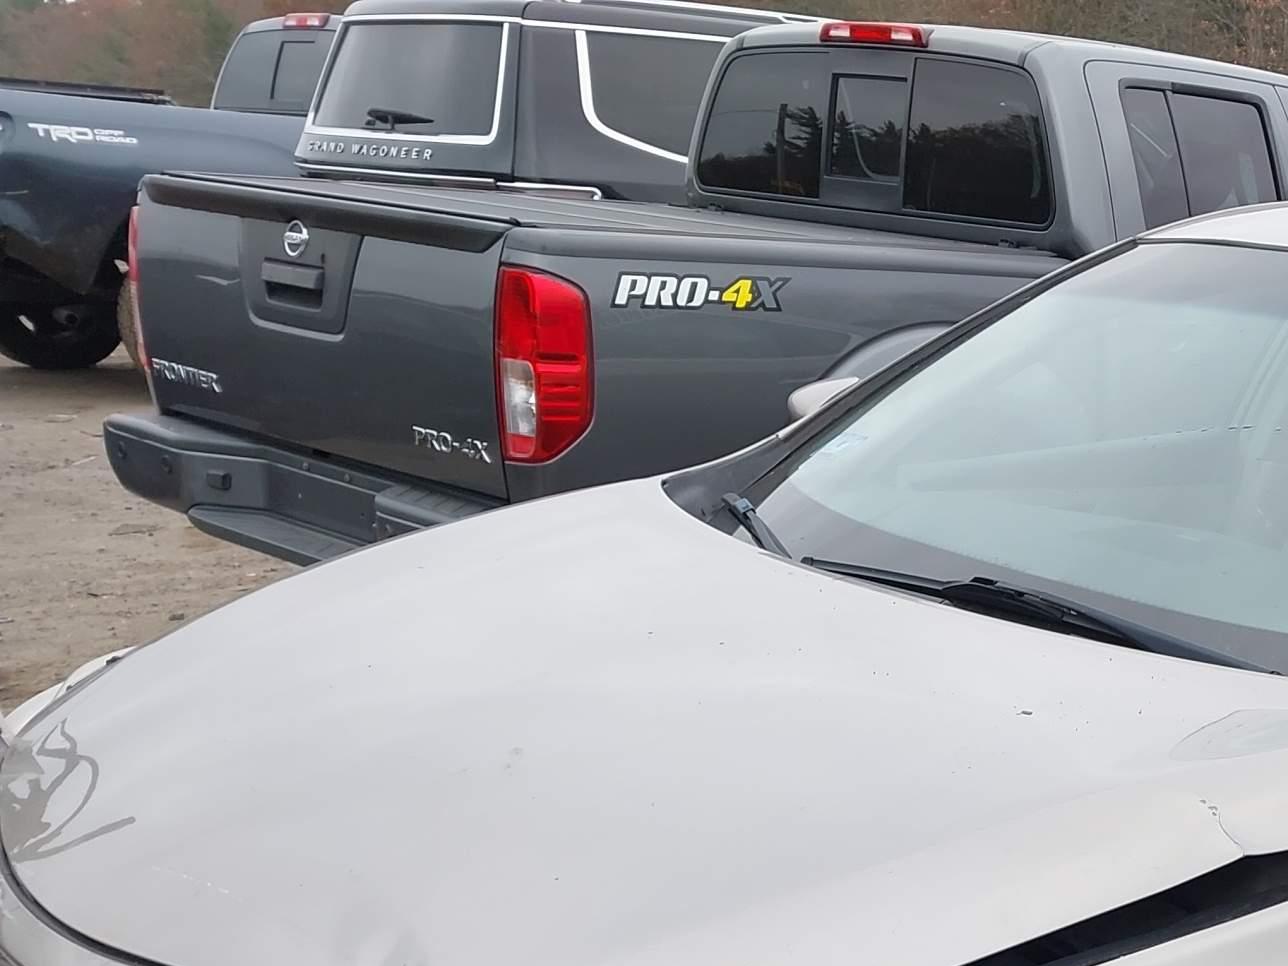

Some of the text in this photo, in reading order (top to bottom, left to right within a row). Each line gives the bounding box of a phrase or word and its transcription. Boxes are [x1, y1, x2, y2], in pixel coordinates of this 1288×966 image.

[27, 122, 94, 143] TRD
[95, 135, 138, 144] ROAD
[307, 140, 433, 160] GRAND WAGONEER
[610, 271, 792, 312] PRO-4X
[151, 357, 222, 393] FRONTIER
[411, 425, 491, 464] PRO-4X
